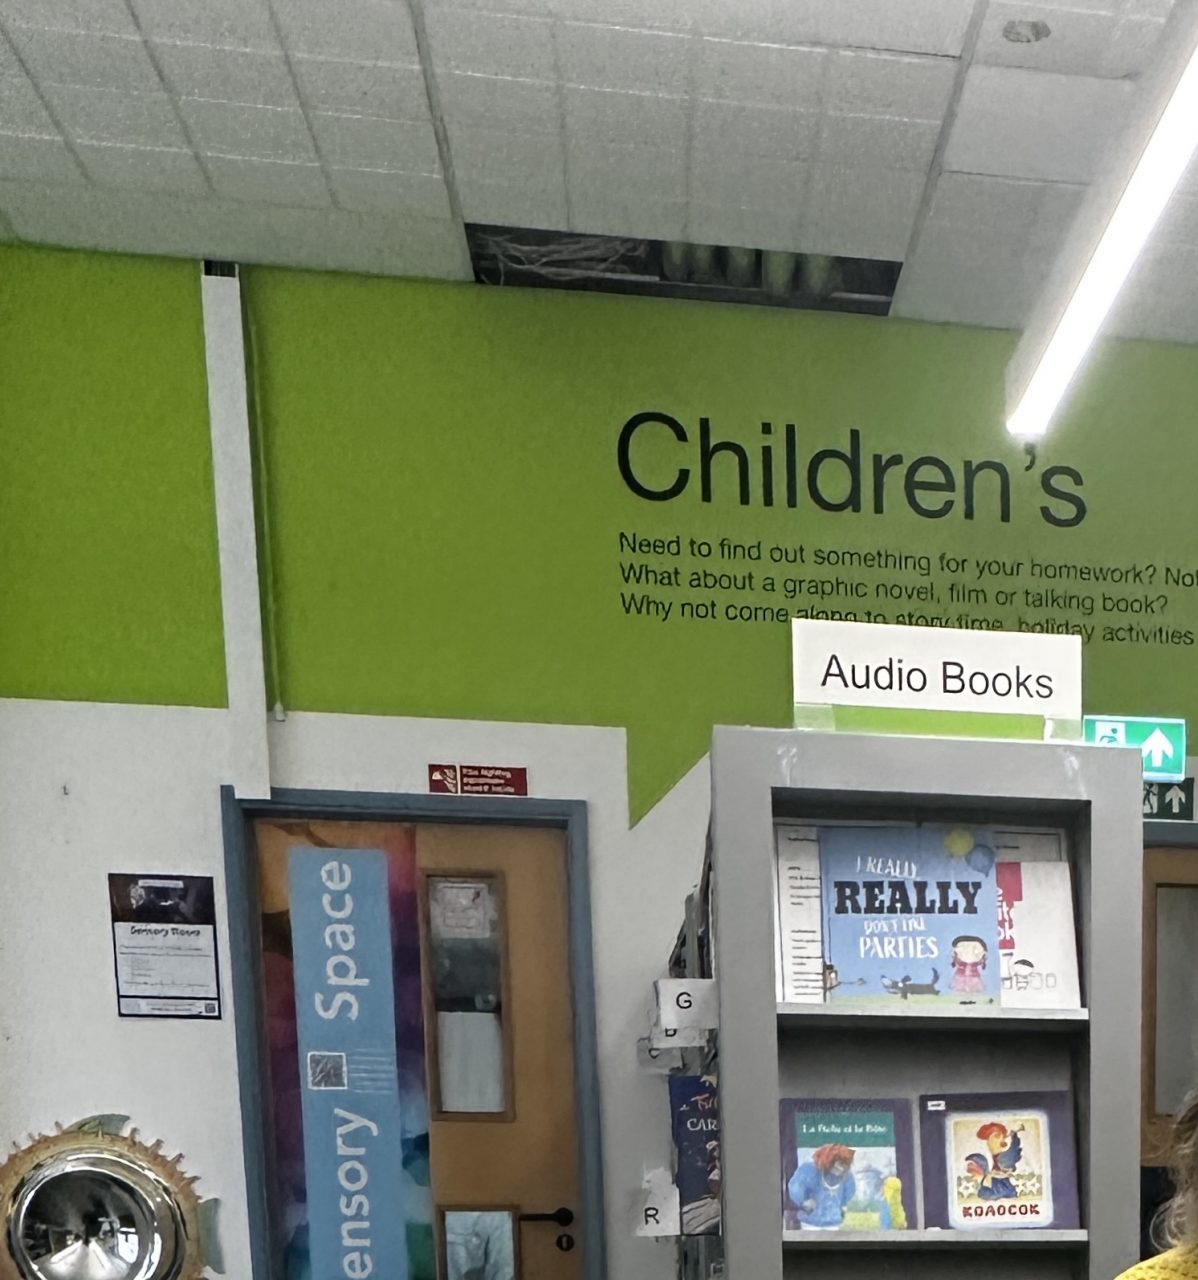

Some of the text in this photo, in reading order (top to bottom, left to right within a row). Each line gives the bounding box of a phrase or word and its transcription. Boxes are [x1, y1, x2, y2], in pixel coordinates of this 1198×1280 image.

[616, 410, 1088, 527] Children's
[619, 531, 681, 555] Need
[690, 538, 711, 557] to
[720, 538, 762, 560] find
[769, 544, 805, 564] out
[813, 547, 931, 576] something
[939, 552, 968, 573] for
[976, 556, 1024, 579] your
[1030, 558, 1156, 585] homework?
[619, 562, 1168, 616] What about a graphic novel, film or talking book?
[620, 592, 672, 622] Why
[680, 599, 717, 619] not
[724, 603, 789, 623] come
[1101, 623, 1195, 646] activities
[820, 653, 1054, 699] Audio Books
[833, 880, 982, 915] REALLY
[314, 859, 370, 1021] Space
[859, 935, 940, 960] PARTIES
[675, 990, 693, 1010] G
[644, 1207, 660, 1225] R
